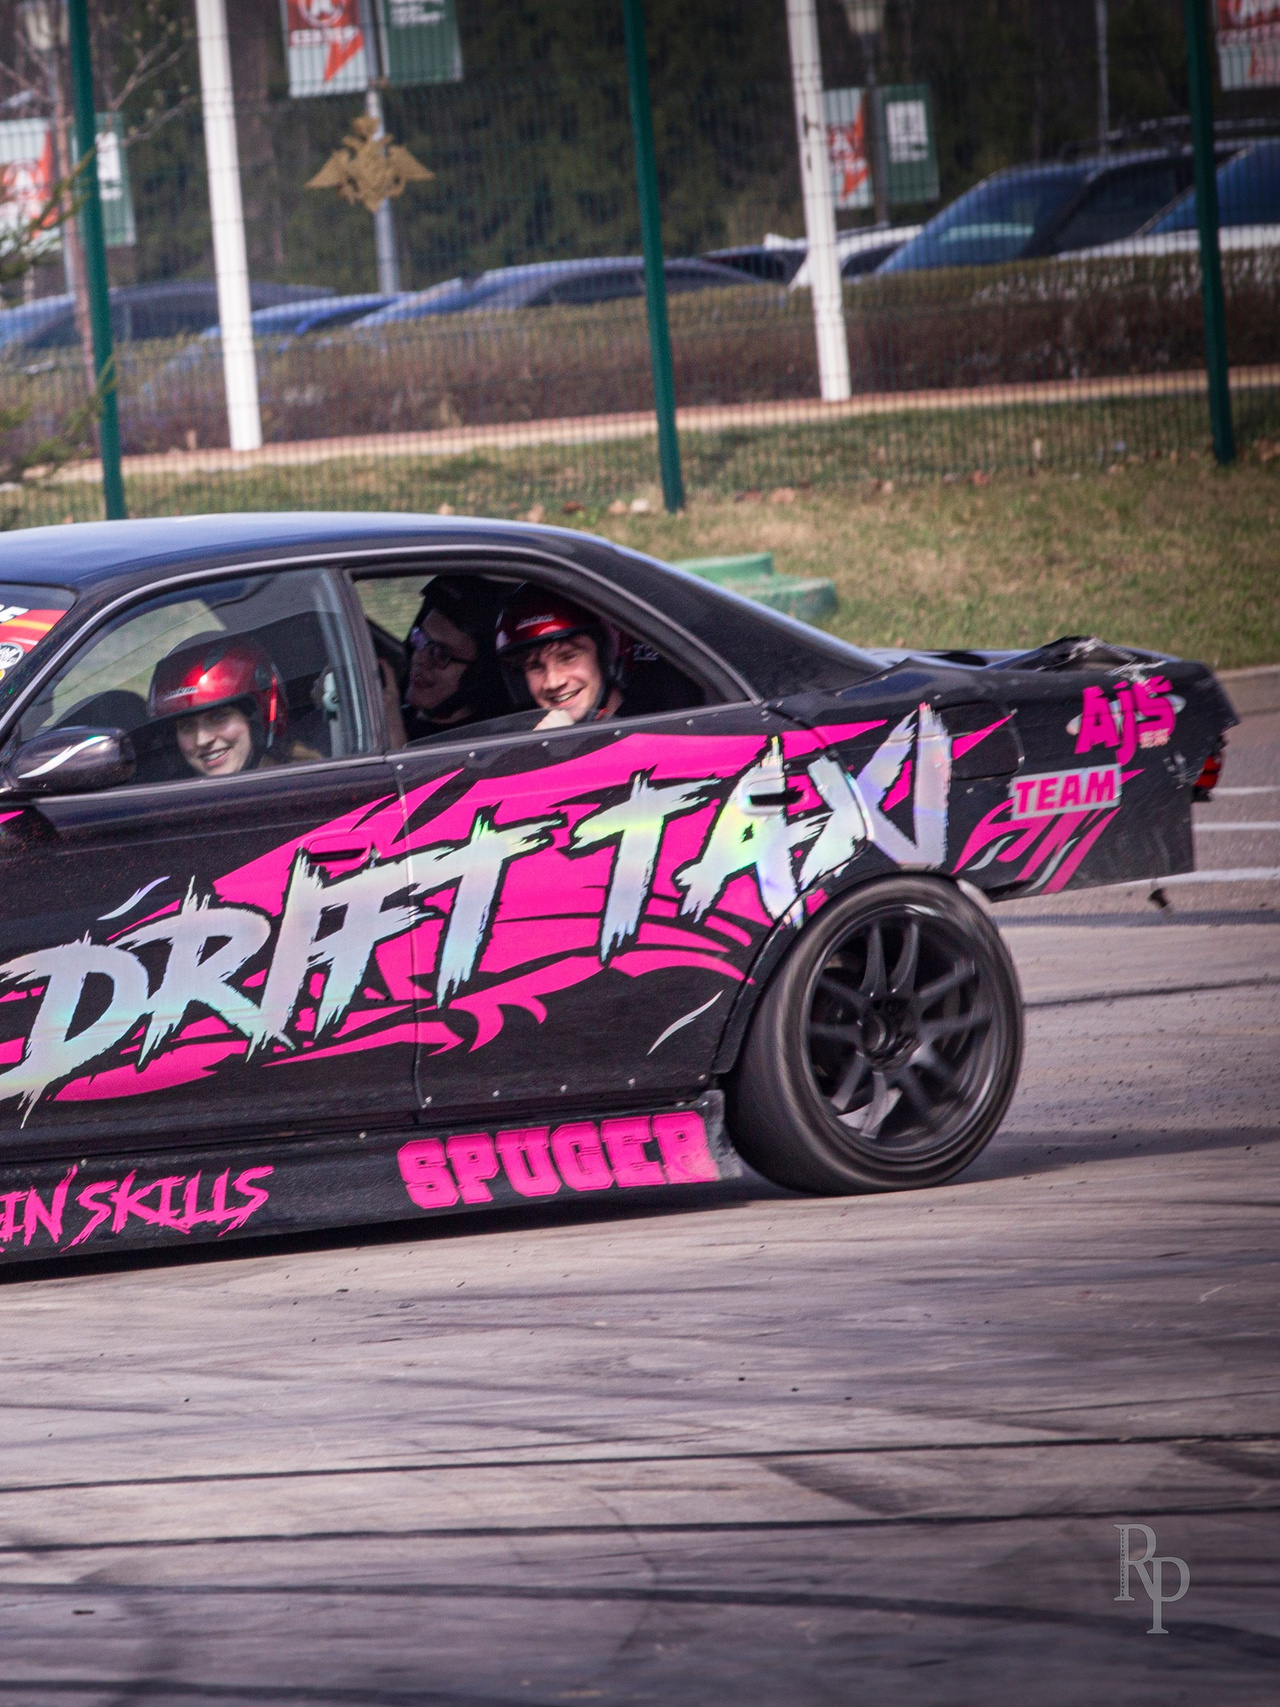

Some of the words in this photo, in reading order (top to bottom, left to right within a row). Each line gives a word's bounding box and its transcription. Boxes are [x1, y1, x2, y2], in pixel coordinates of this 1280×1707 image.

[568, 703, 953, 966] TAXI
[1014, 769, 1117, 815] TEAM
[397, 1110, 719, 1209] SPUGER
[61, 1164, 275, 1252] SKILLS
